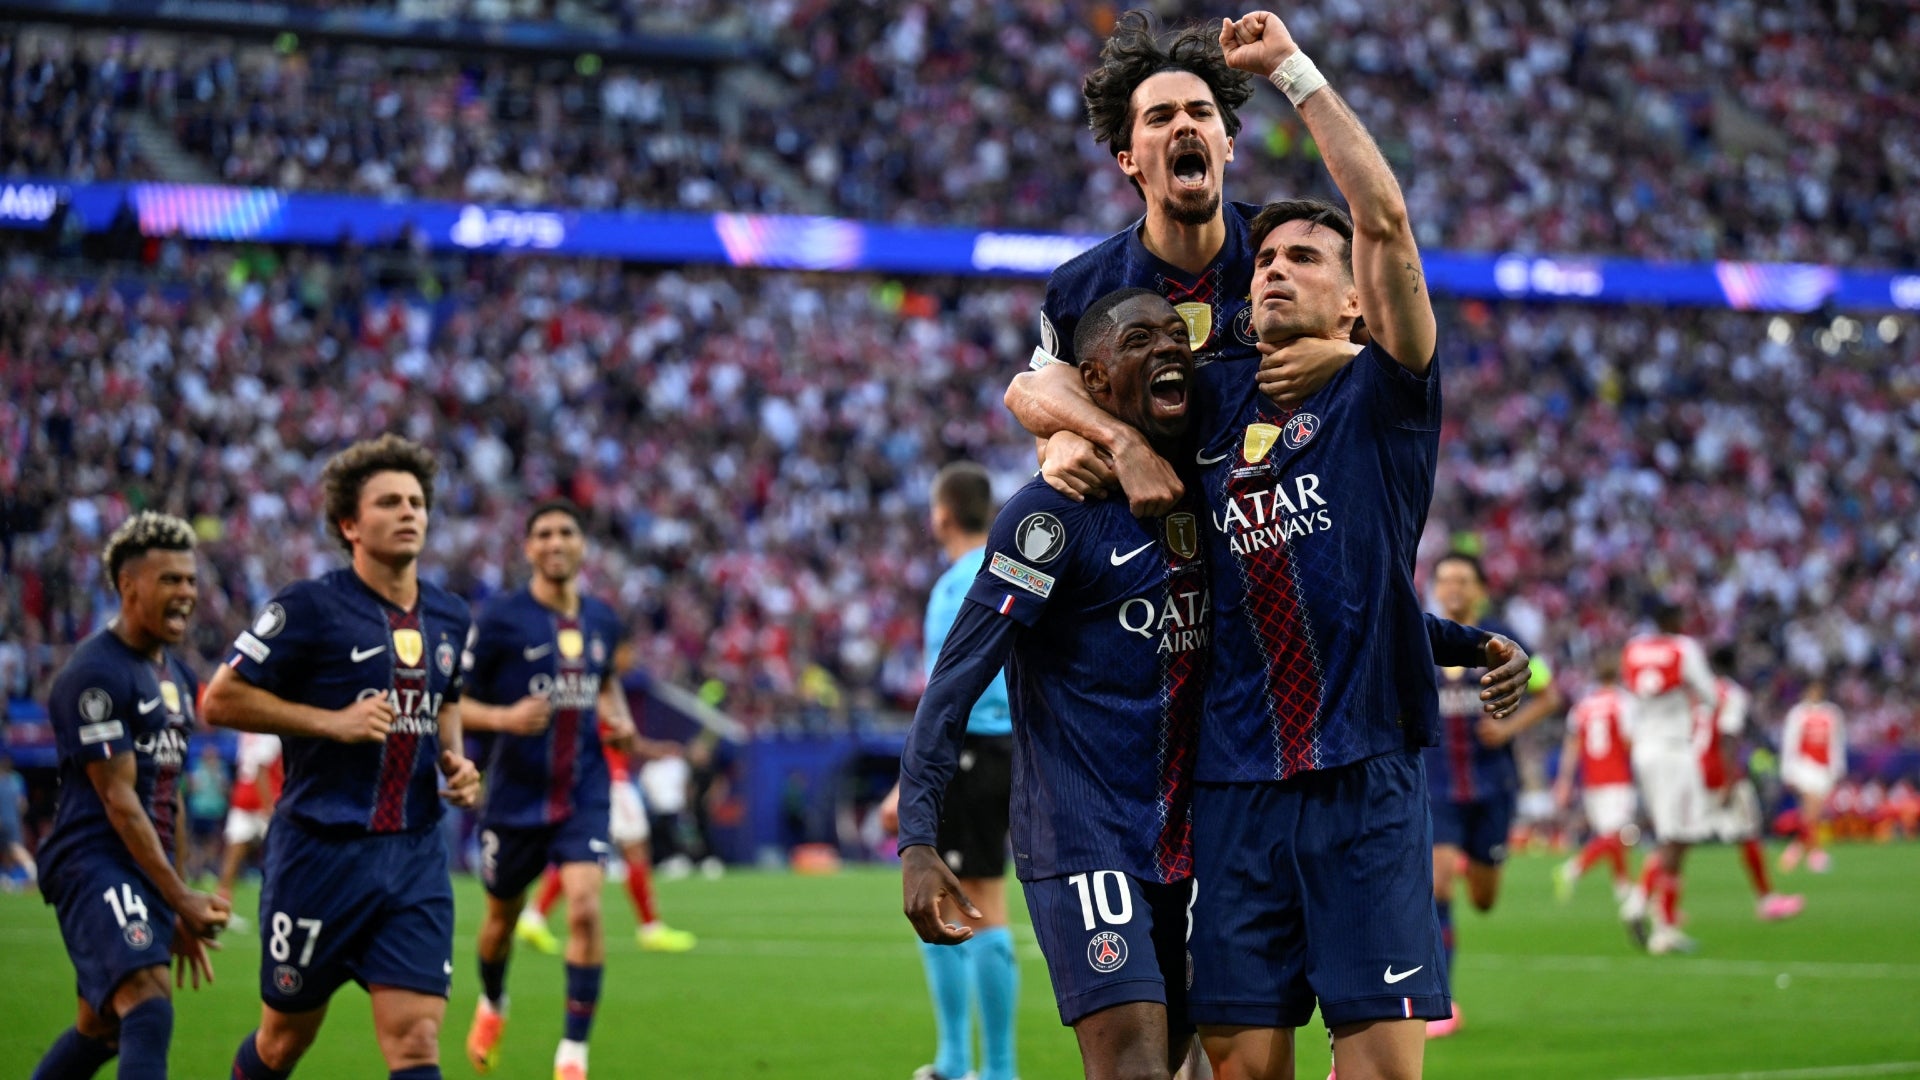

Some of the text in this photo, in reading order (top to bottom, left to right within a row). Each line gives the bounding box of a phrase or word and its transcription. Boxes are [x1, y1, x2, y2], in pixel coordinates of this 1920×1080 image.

[1287, 415, 1312, 430] PARIS
[1230, 509, 1332, 555] AIRWAYS
[992, 558, 1051, 591] FOUNDATION
[1118, 590, 1211, 640] QATA
[1156, 626, 1210, 654] AIRW
[103, 882, 148, 929] 14
[1068, 870, 1133, 931] 10
[269, 911, 323, 968] 87
[1091, 933, 1119, 946] PARIS
